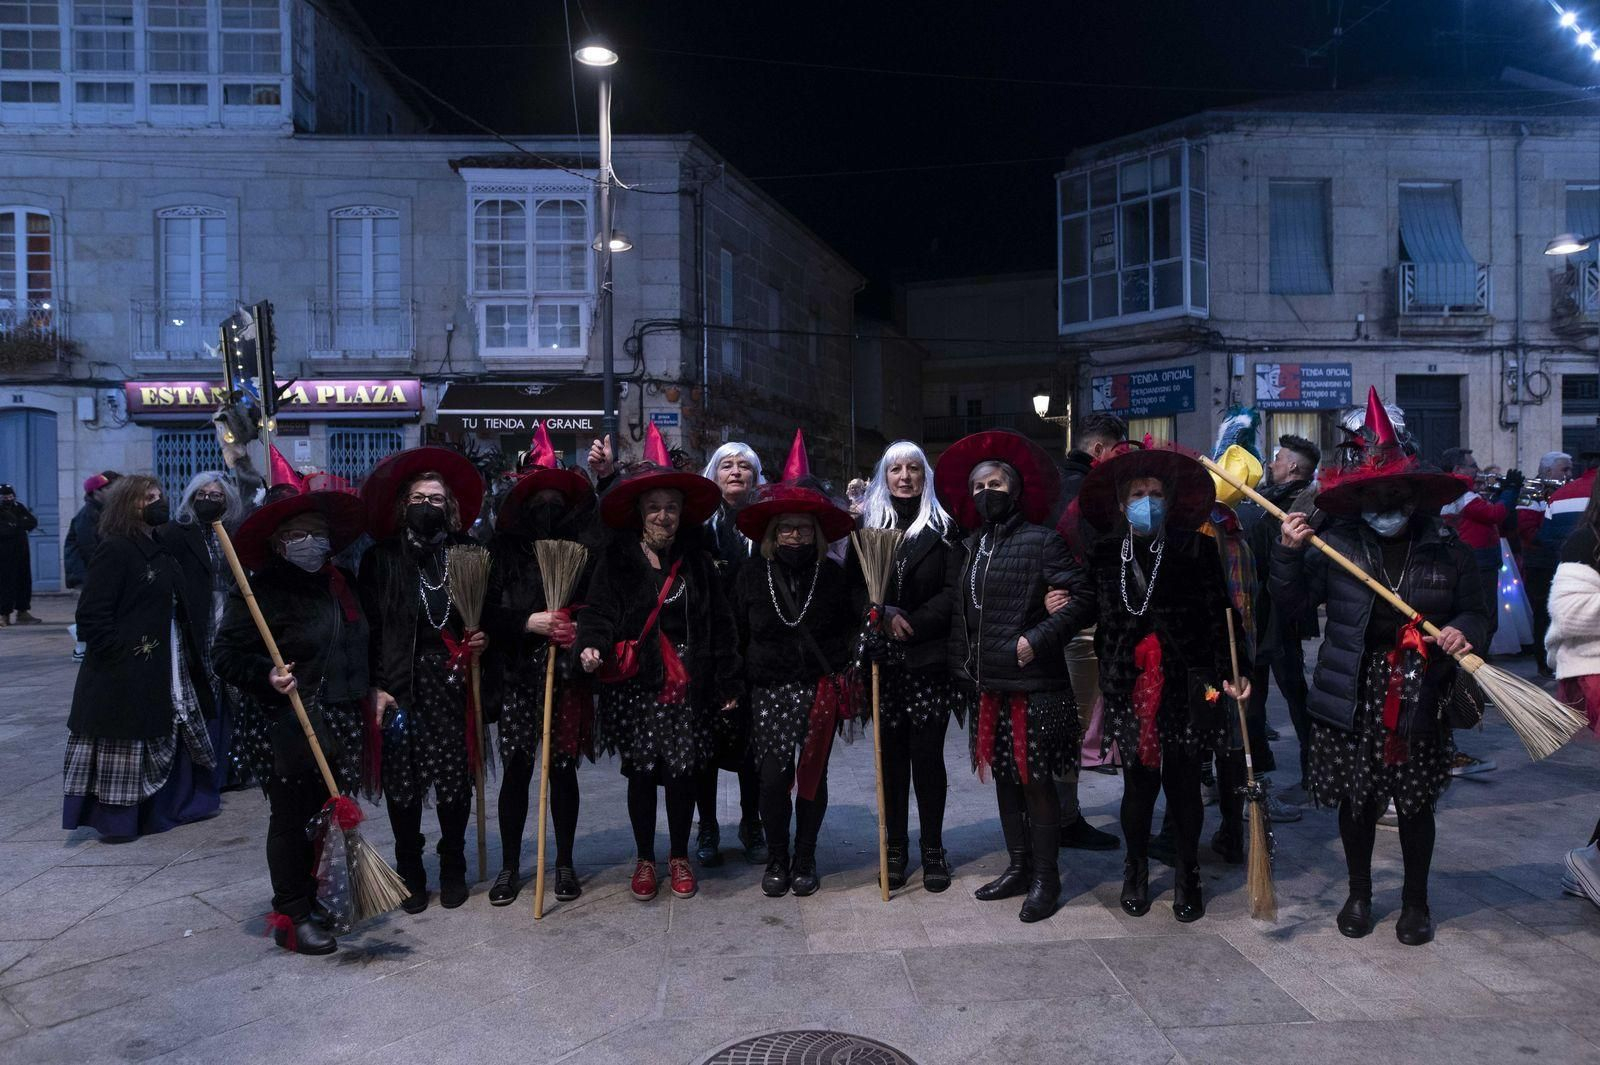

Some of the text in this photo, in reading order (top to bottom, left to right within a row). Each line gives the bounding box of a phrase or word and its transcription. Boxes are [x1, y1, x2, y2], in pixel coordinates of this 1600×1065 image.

[1131, 369, 1193, 385] TENDA OFICIAL
[1301, 368, 1350, 376] TENDA OFICIAL
[140, 387, 227, 405] ESTAN
[315, 386, 407, 404] PLAZA
[462, 418, 593, 429] TU TIENDA A GRANEL
